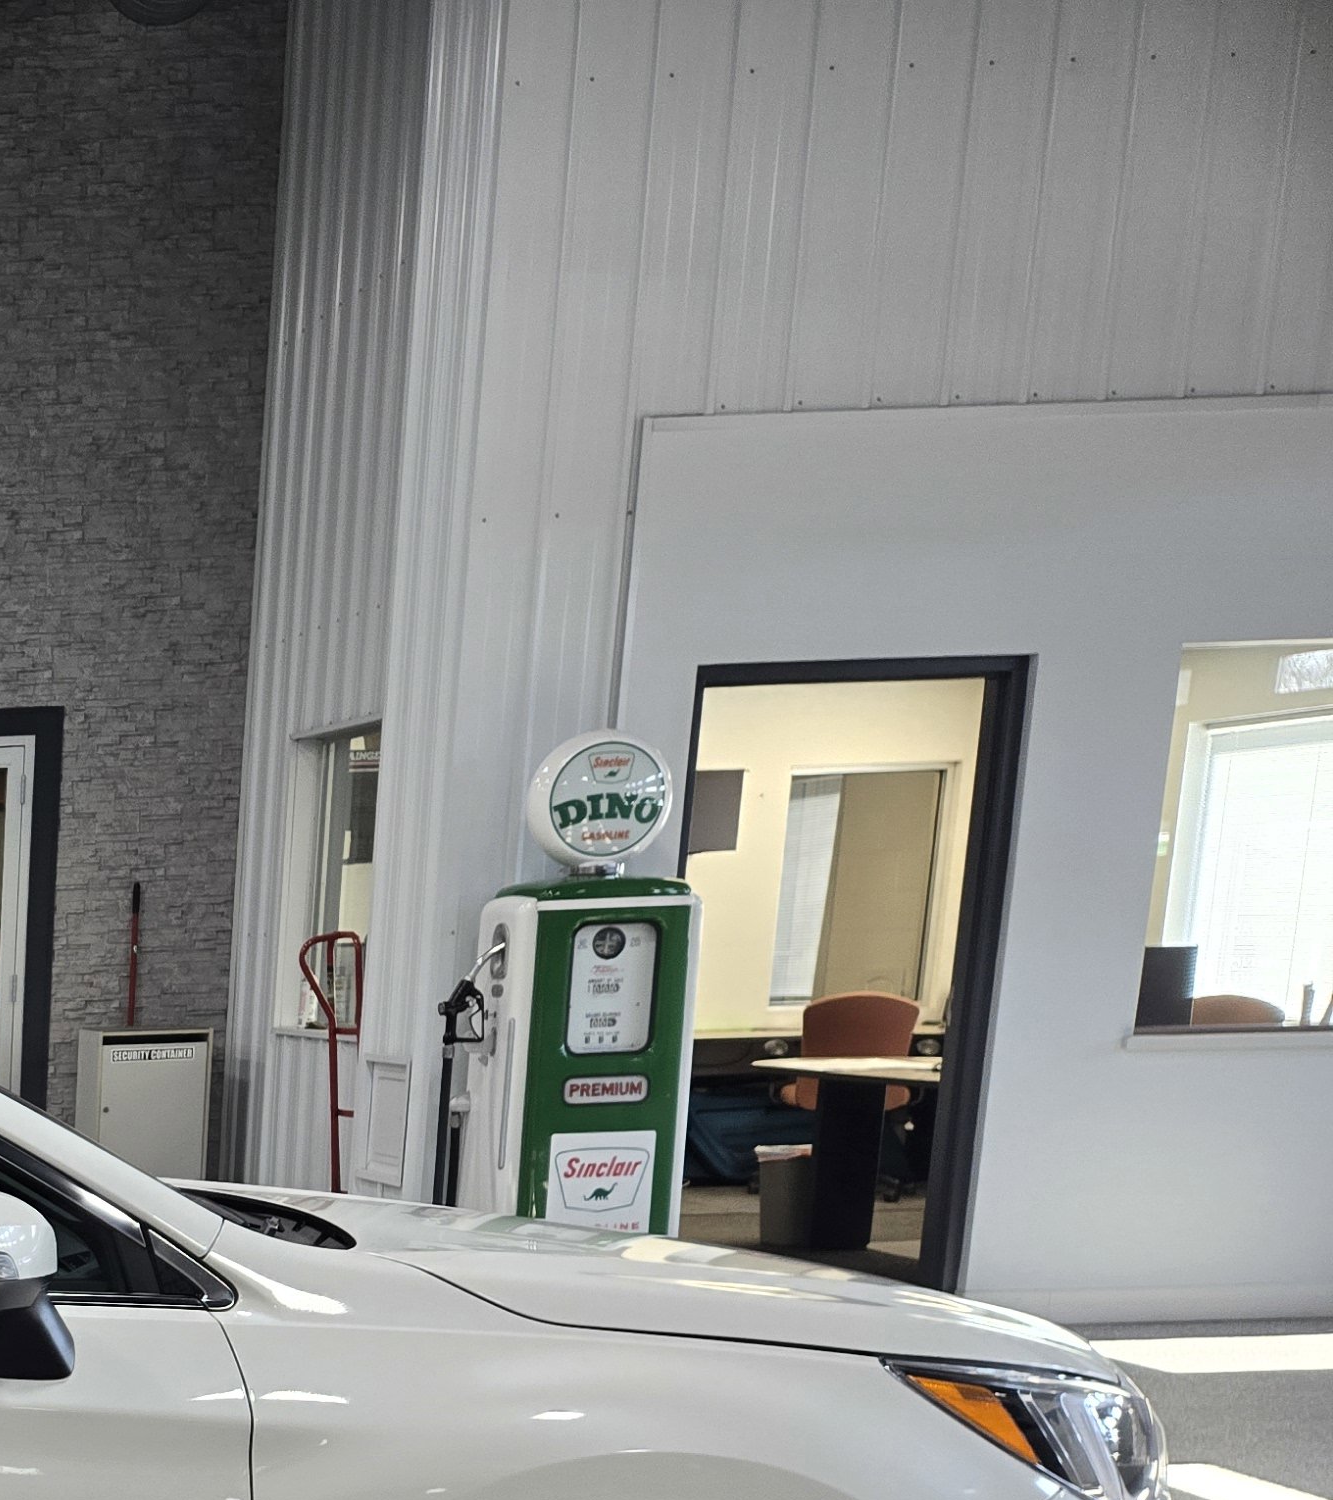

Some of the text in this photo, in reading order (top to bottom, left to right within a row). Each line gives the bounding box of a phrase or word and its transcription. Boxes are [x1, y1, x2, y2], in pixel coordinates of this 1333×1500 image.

[552, 792, 659, 830] DINO
[113, 1048, 193, 1062] SECURITY CONTAINER
[569, 1081, 643, 1098] PREMIUM
[564, 1156, 643, 1179] Sinclair
